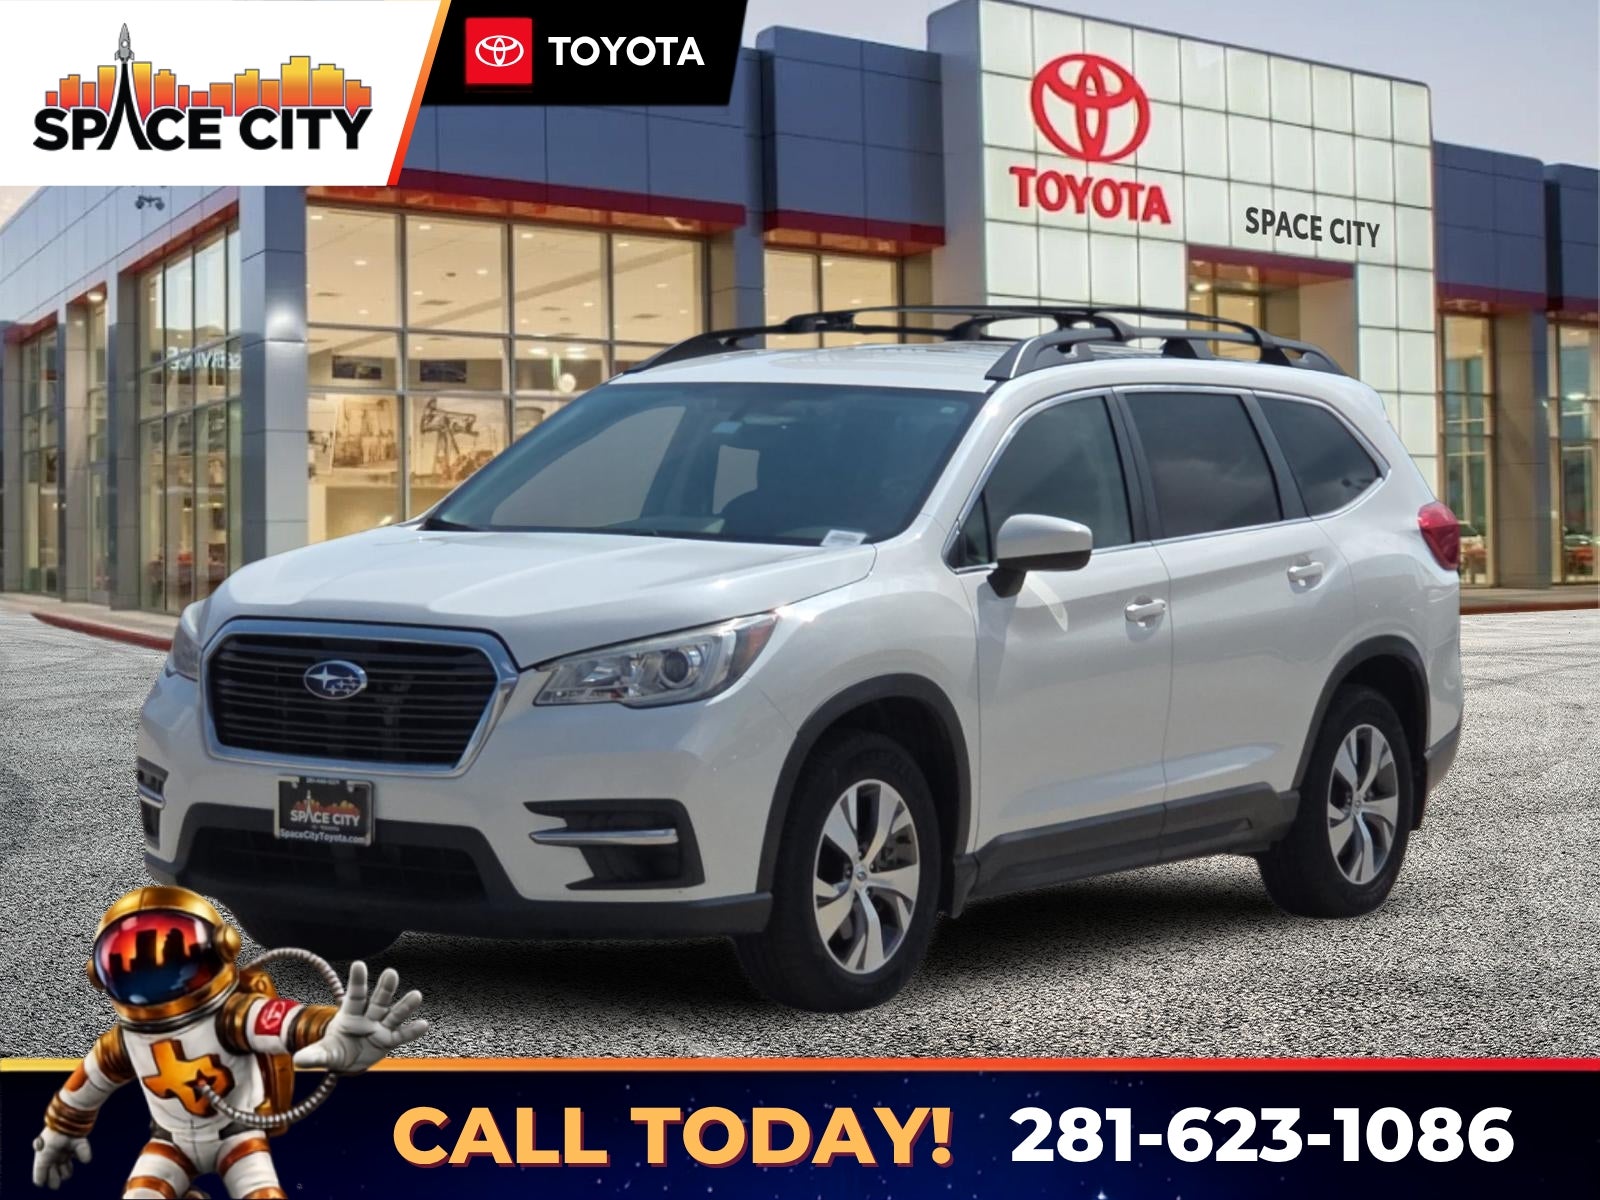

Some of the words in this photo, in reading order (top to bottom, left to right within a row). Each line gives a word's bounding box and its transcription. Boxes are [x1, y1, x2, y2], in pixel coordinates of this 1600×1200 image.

[1010, 166, 1171, 225] TOYOTA
[1245, 206, 1323, 242] SPACE
[1329, 216, 1381, 249] CITY
[290, 809, 330, 824] SPACE
[332, 813, 361, 827] CITY
[280, 828, 366, 844] SpaceCityToyota.com
